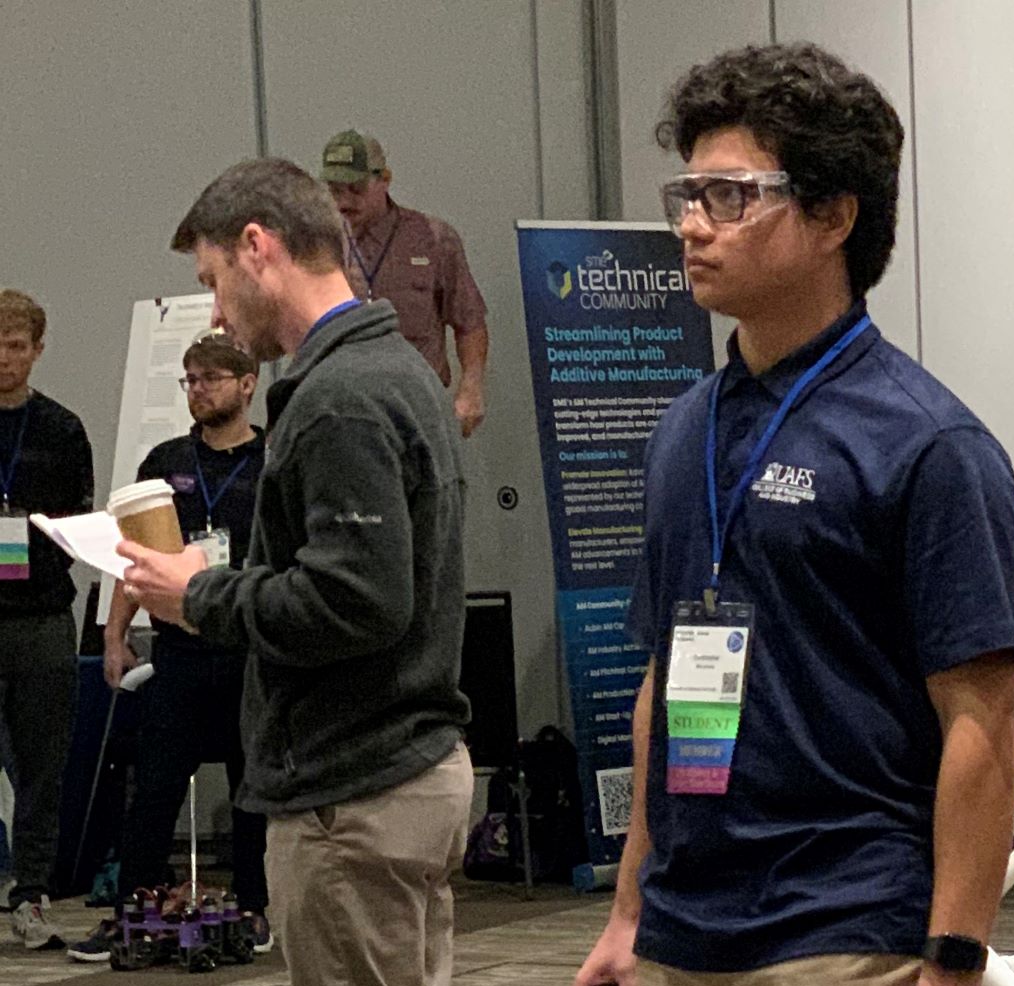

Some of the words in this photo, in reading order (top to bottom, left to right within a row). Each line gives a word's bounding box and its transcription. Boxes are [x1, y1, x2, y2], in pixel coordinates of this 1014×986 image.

[577, 259, 690, 292] technical
[580, 293, 668, 310] COMMUNITY
[545, 325, 632, 345] Streamlining
[633, 326, 683, 341] Product
[547, 347, 636, 366] Development
[639, 345, 666, 360] with
[551, 366, 606, 382] Additive
[608, 365, 703, 382] Manufacturing
[559, 451, 576, 461] Our
[576, 449, 609, 460] mission
[673, 716, 733, 731] STUDENT
